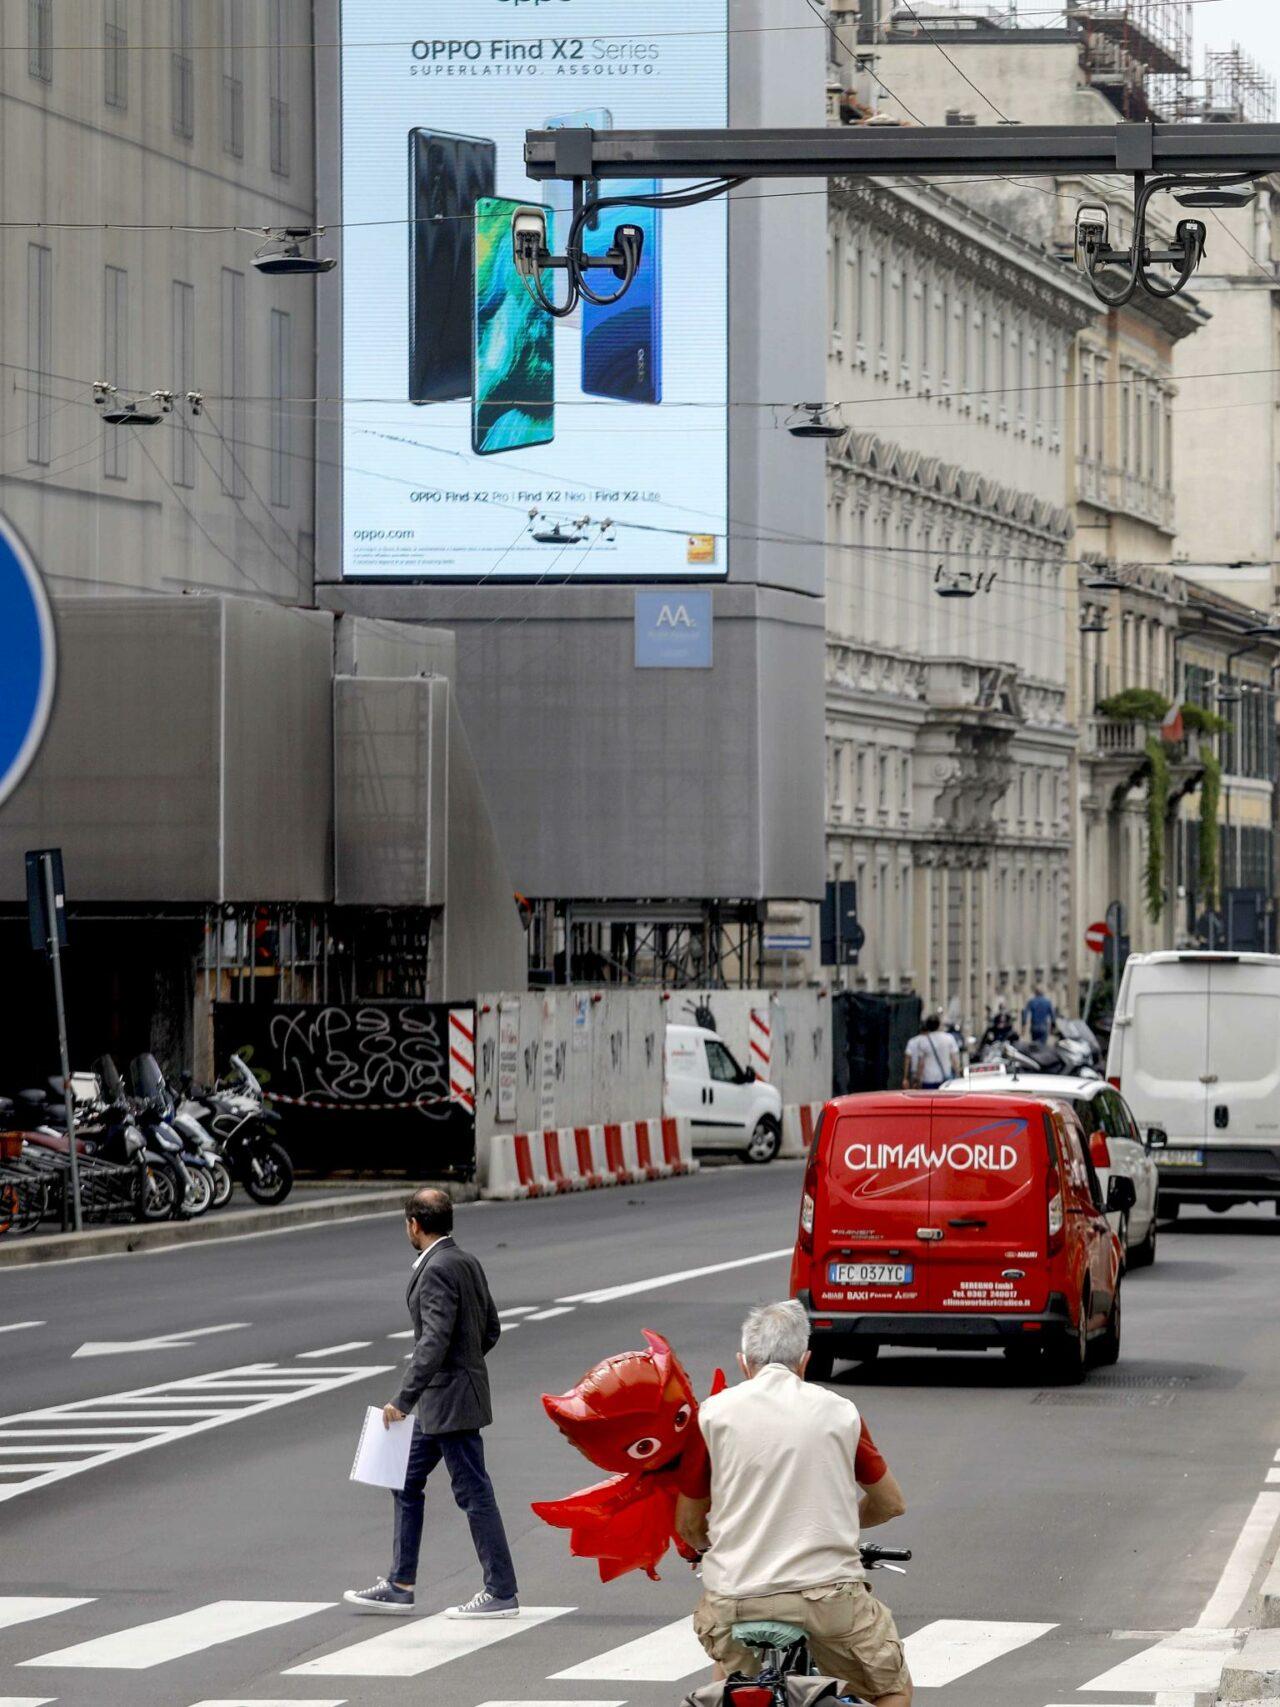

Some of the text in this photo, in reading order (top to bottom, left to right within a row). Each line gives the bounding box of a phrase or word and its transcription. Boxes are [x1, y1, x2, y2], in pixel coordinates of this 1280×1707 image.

[412, 39, 660, 60] OPPO Find X2 Series
[410, 65, 661, 76] SUPERLATIVO. ASSOLUTO.
[410, 491, 441, 502] OPPO
[445, 491, 469, 502] Find
[473, 491, 489, 502] X2
[517, 491, 542, 502] Find
[546, 491, 562, 502] X2
[594, 491, 619, 502] Find
[623, 491, 639, 502] X2
[353, 528, 415, 541] oppo.com
[844, 1143, 1018, 1171] CLIMAWORLD
[839, 1266, 855, 1280] FC
[860, 1266, 903, 1280] 037YC
